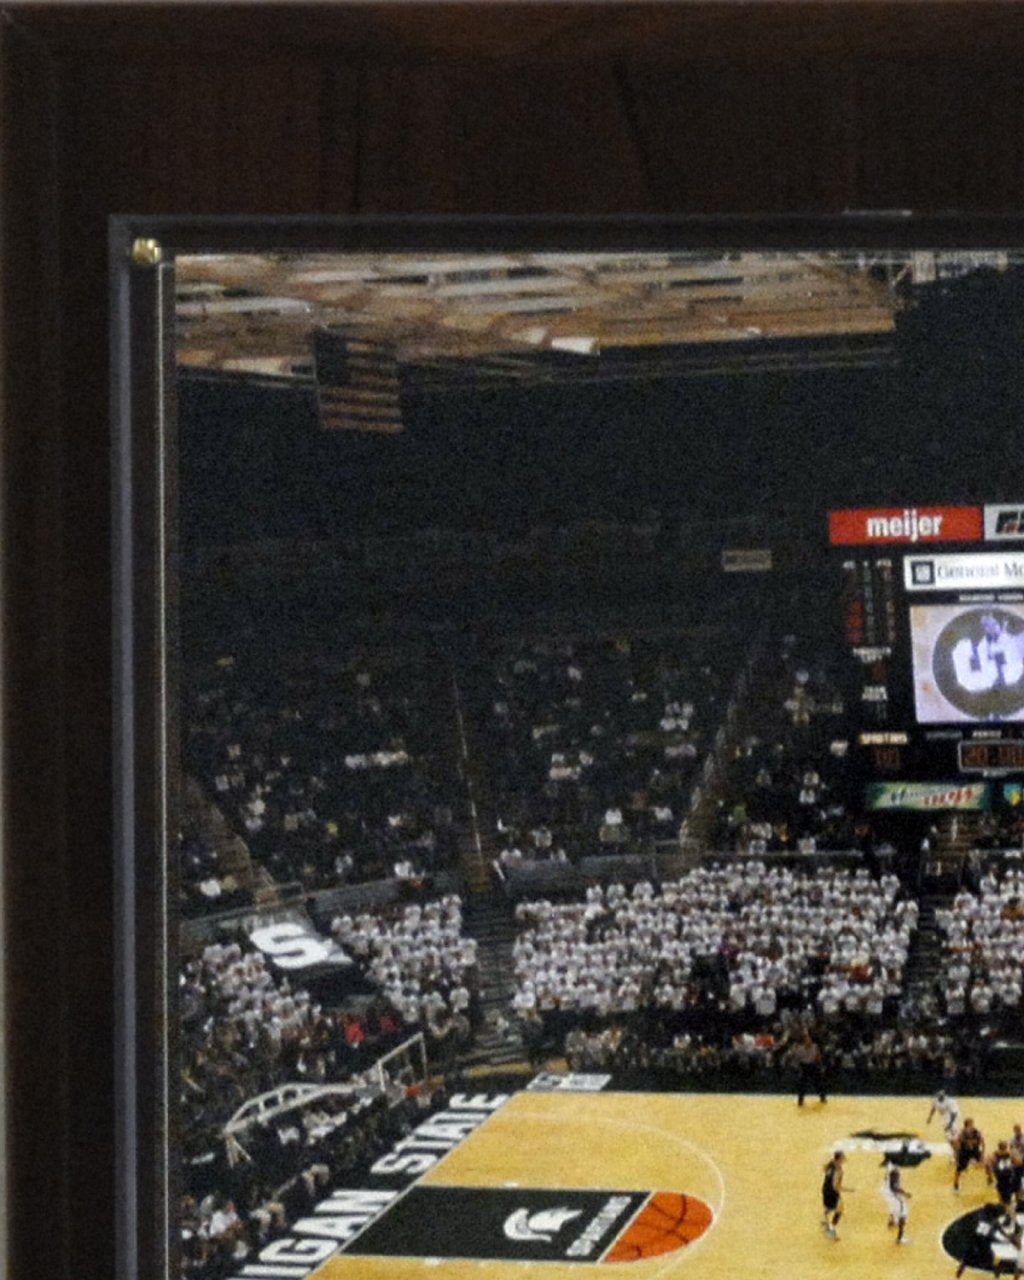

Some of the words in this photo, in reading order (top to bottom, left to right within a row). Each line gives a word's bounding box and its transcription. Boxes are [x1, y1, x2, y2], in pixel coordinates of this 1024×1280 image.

[866, 509, 944, 542] meijer
[937, 563, 1000, 580] General
[370, 1093, 510, 1174] STATE
